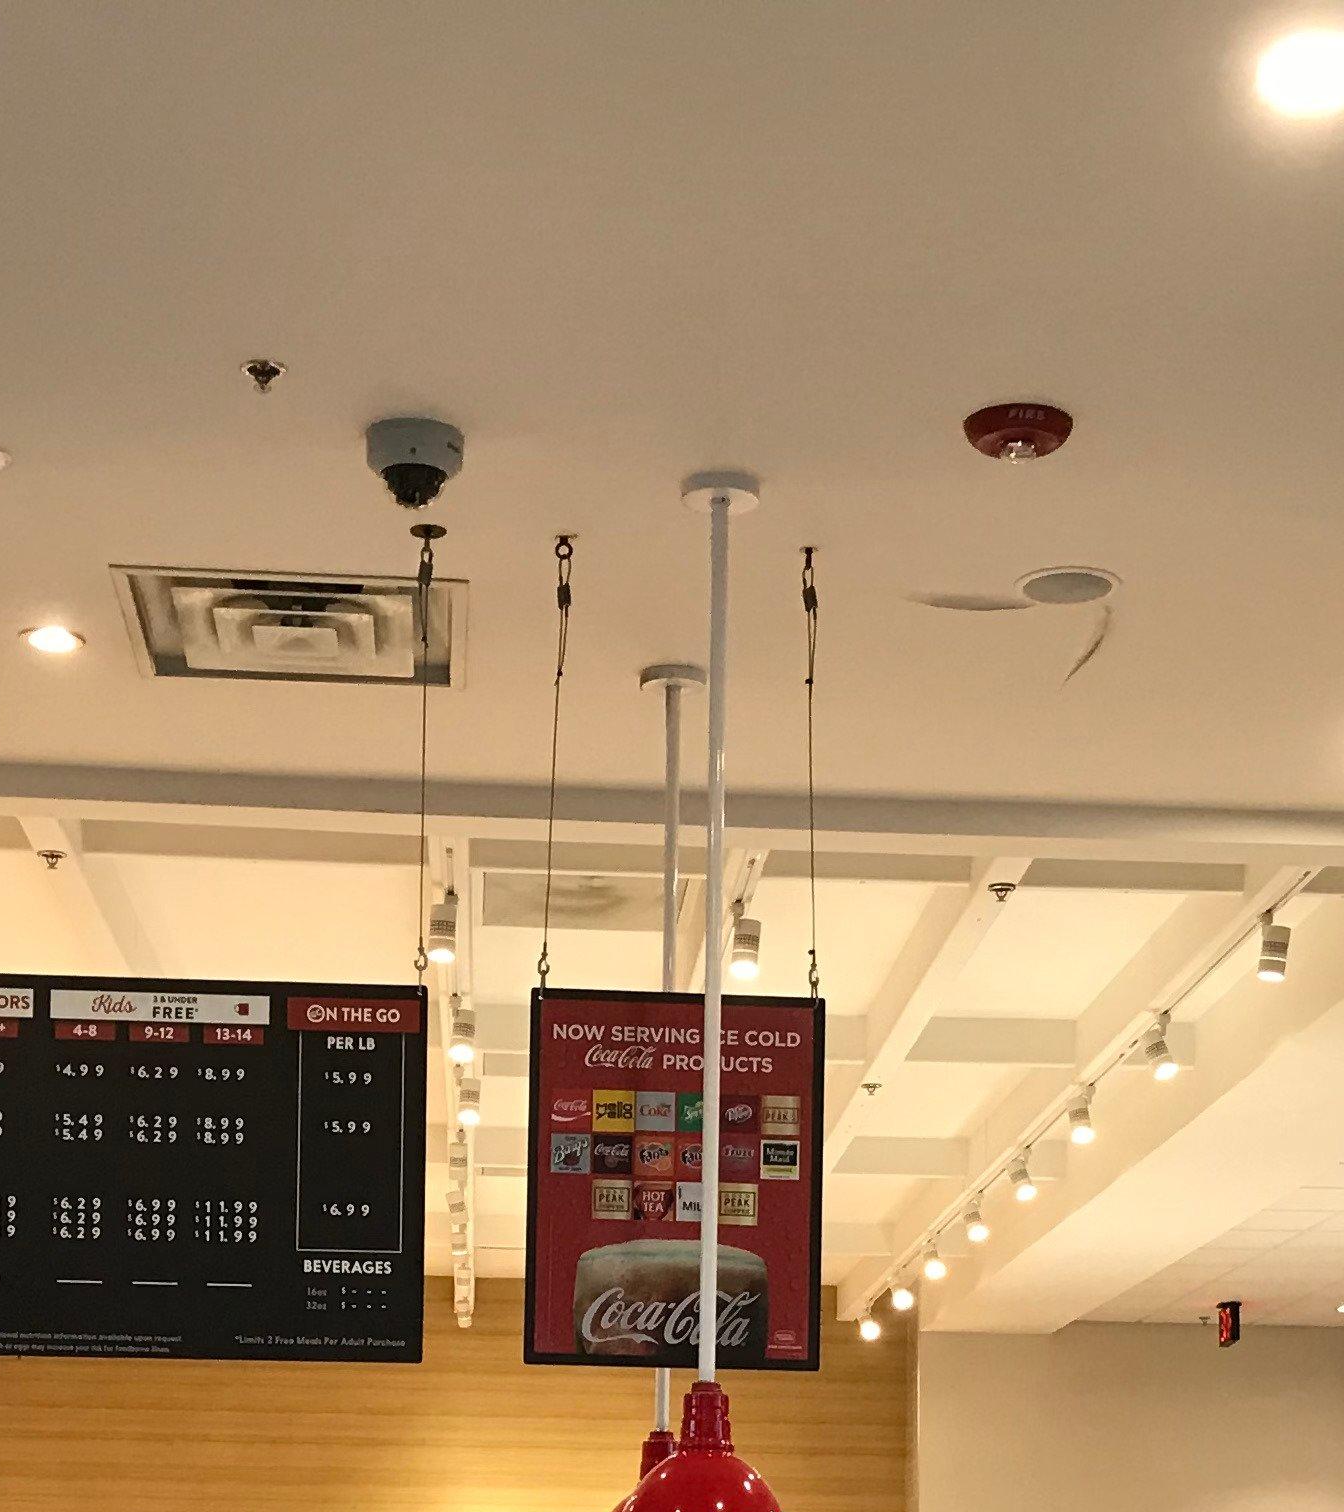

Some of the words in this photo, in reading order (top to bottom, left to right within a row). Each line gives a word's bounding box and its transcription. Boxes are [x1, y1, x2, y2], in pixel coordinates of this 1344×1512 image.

[91, 994, 137, 1014] Kids
[168, 996, 198, 1005] UNDER
[306, 1004, 337, 1023] ON
[341, 1007, 372, 1022] THE
[376, 1008, 400, 1023] GO
[72, 1024, 97, 1037] 4-8
[145, 1026, 174, 1039] 9-12
[216, 1028, 252, 1041] 13-14
[552, 1023, 605, 1041] NOW
[611, 1025, 700, 1044] SERVING
[744, 1030, 801, 1048] COLD
[327, 1036, 354, 1050] PER
[358, 1037, 375, 1050] LB
[584, 1043, 656, 1069] Coca-Cola
[662, 1055, 773, 1073] PROUCTS
[598, 1193, 625, 1204] PEAK
[642, 1190, 666, 1202] HOT
[643, 1202, 664, 1213] TEA
[682, 1201, 702, 1212] MIL
[724, 1198, 750, 1208] PEAK
[303, 1259, 392, 1275] BEVERAGES
